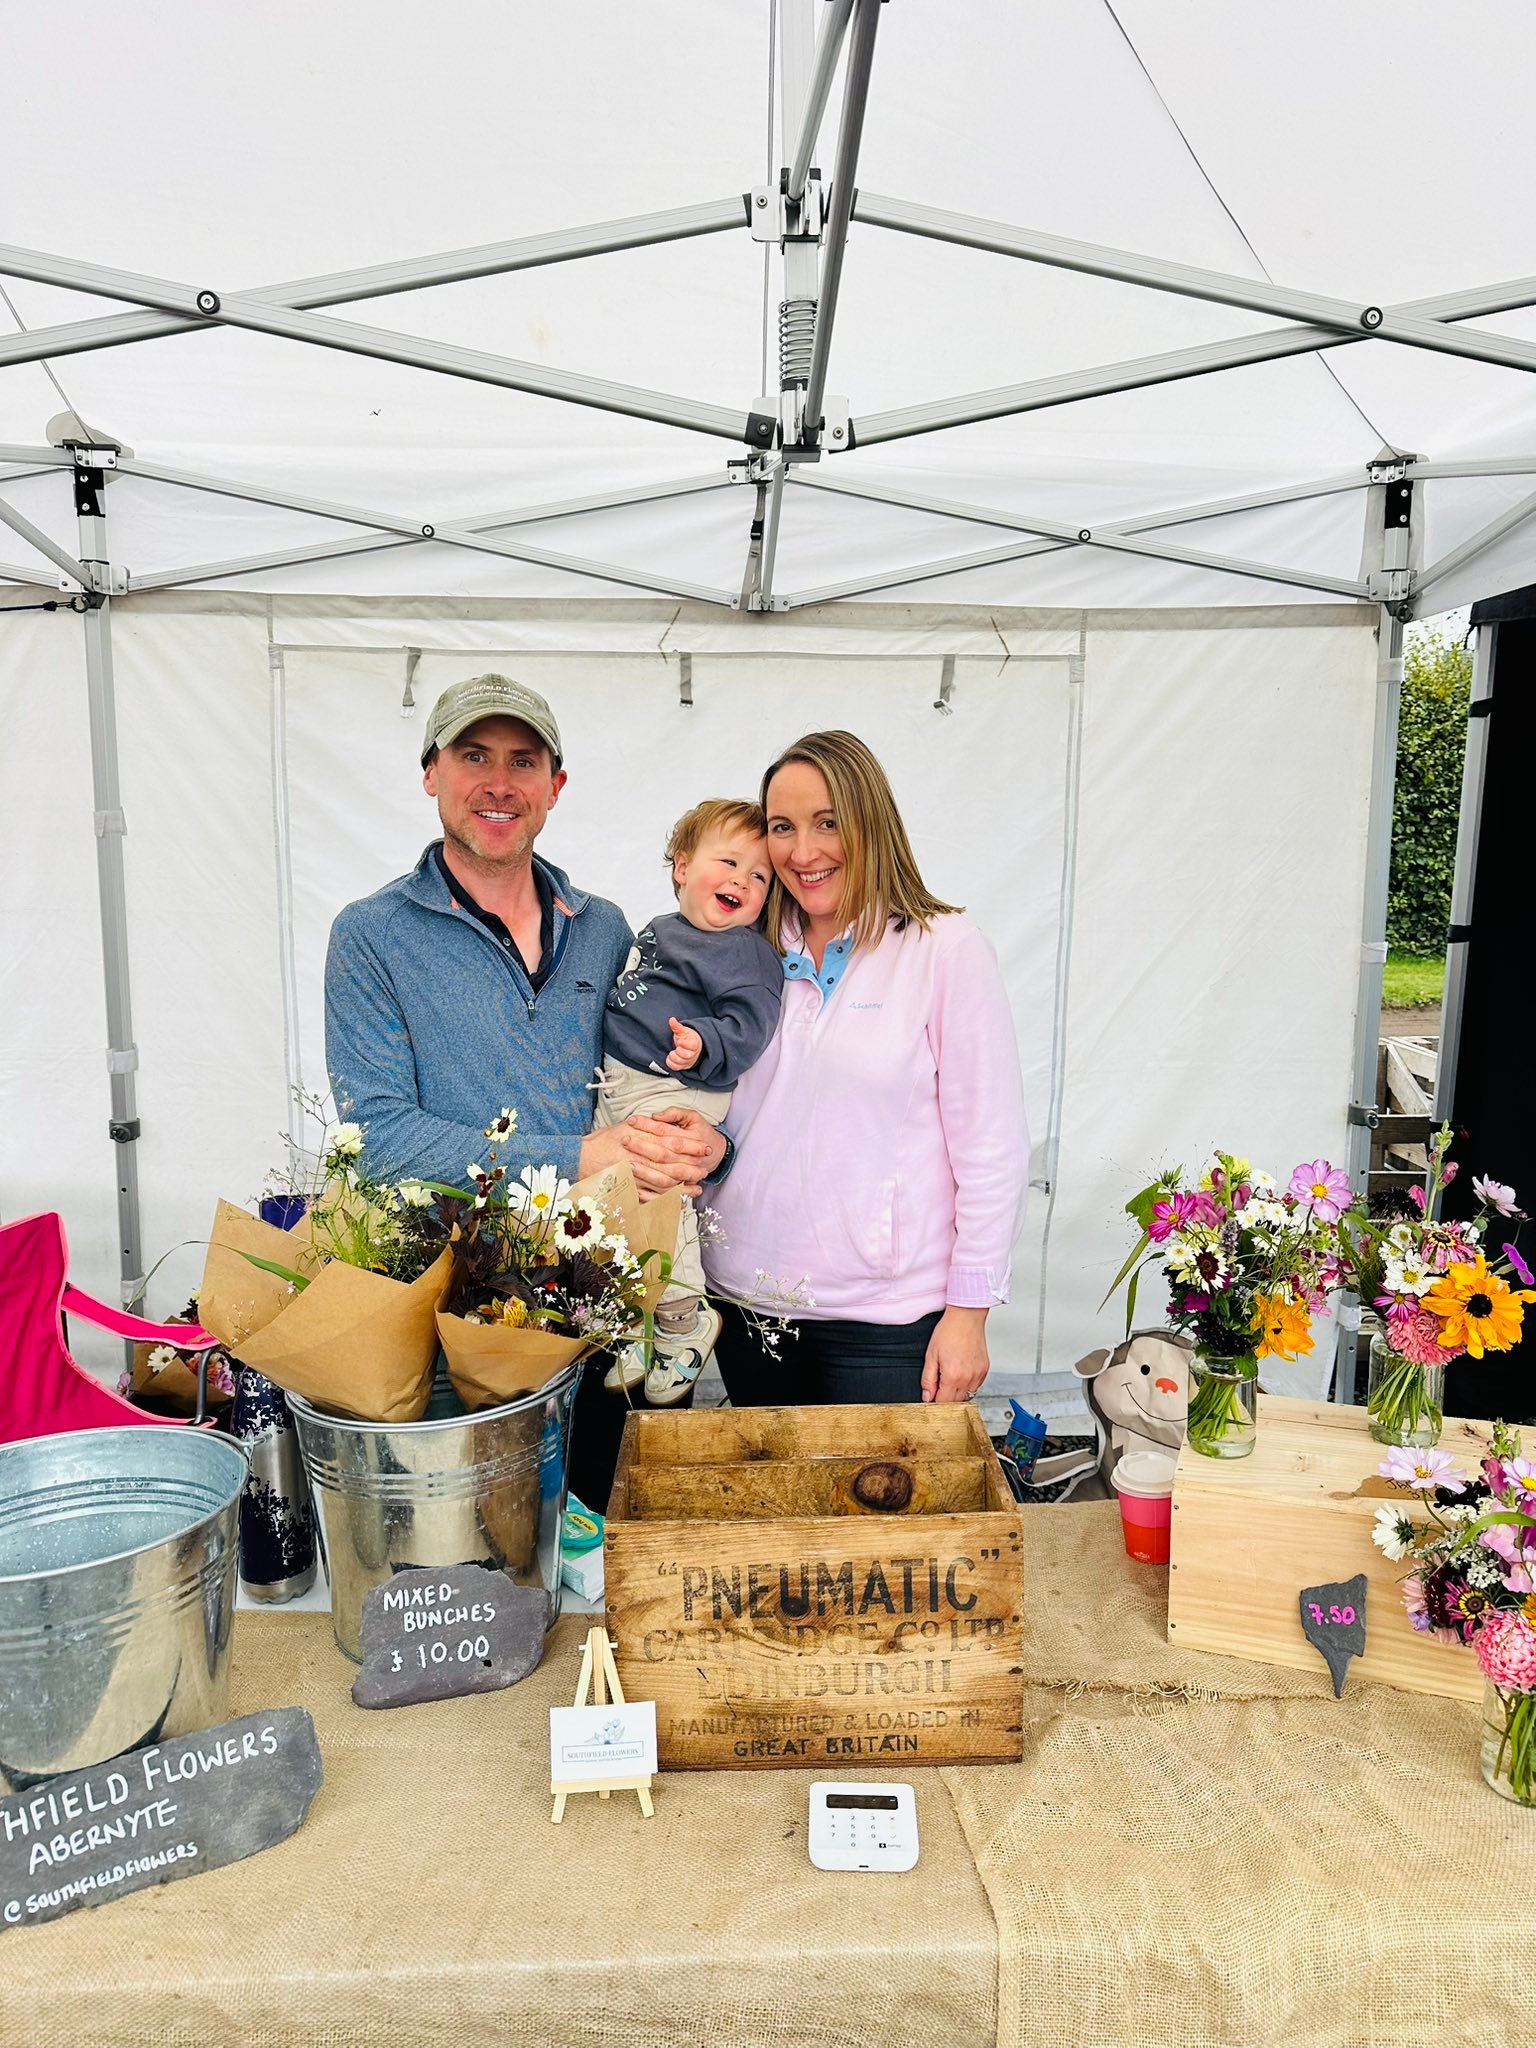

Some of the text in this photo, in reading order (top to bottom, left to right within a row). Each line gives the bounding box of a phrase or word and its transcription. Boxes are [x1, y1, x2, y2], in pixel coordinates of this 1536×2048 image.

[403, 1602, 496, 1632] BUNCHES
[1308, 1603, 1356, 1626] 7.50
[643, 1620, 880, 1663] CARTIDGE
[700, 1659, 953, 1700] EDINBURGH
[668, 1708, 982, 1737] MANUFACTURED & LOADED IN
[567, 1748, 639, 1759] SOUTHFIELD FLOWERS
[733, 1733, 919, 1758] GREAT BRITAIN
[28, 1798, 178, 1876] ABERNYTE
